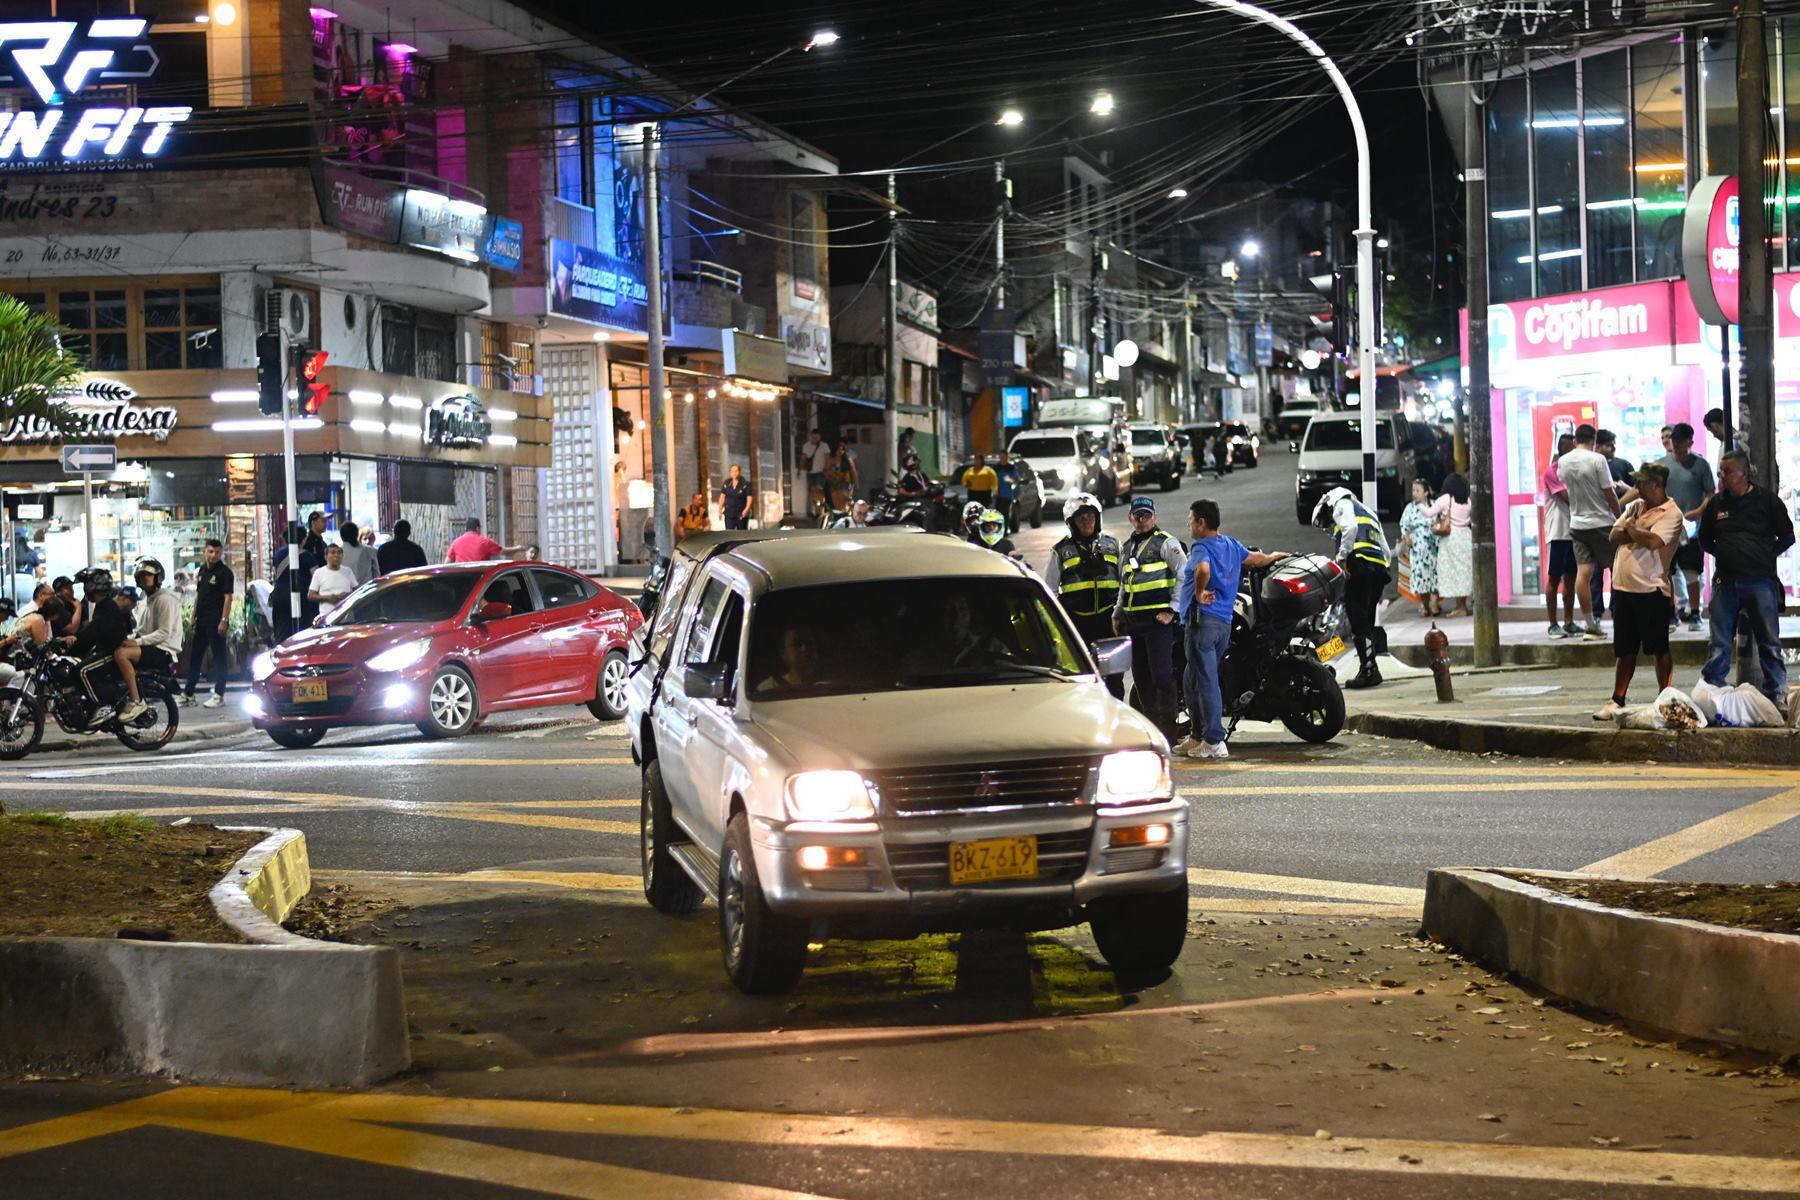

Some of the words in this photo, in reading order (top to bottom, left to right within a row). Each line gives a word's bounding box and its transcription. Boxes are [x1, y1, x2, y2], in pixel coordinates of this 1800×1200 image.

[61, 106, 193, 157] FIT
[82, 196, 118, 219] 23
[6, 249, 24, 262] 20
[1524, 297, 1648, 350] Copifam
